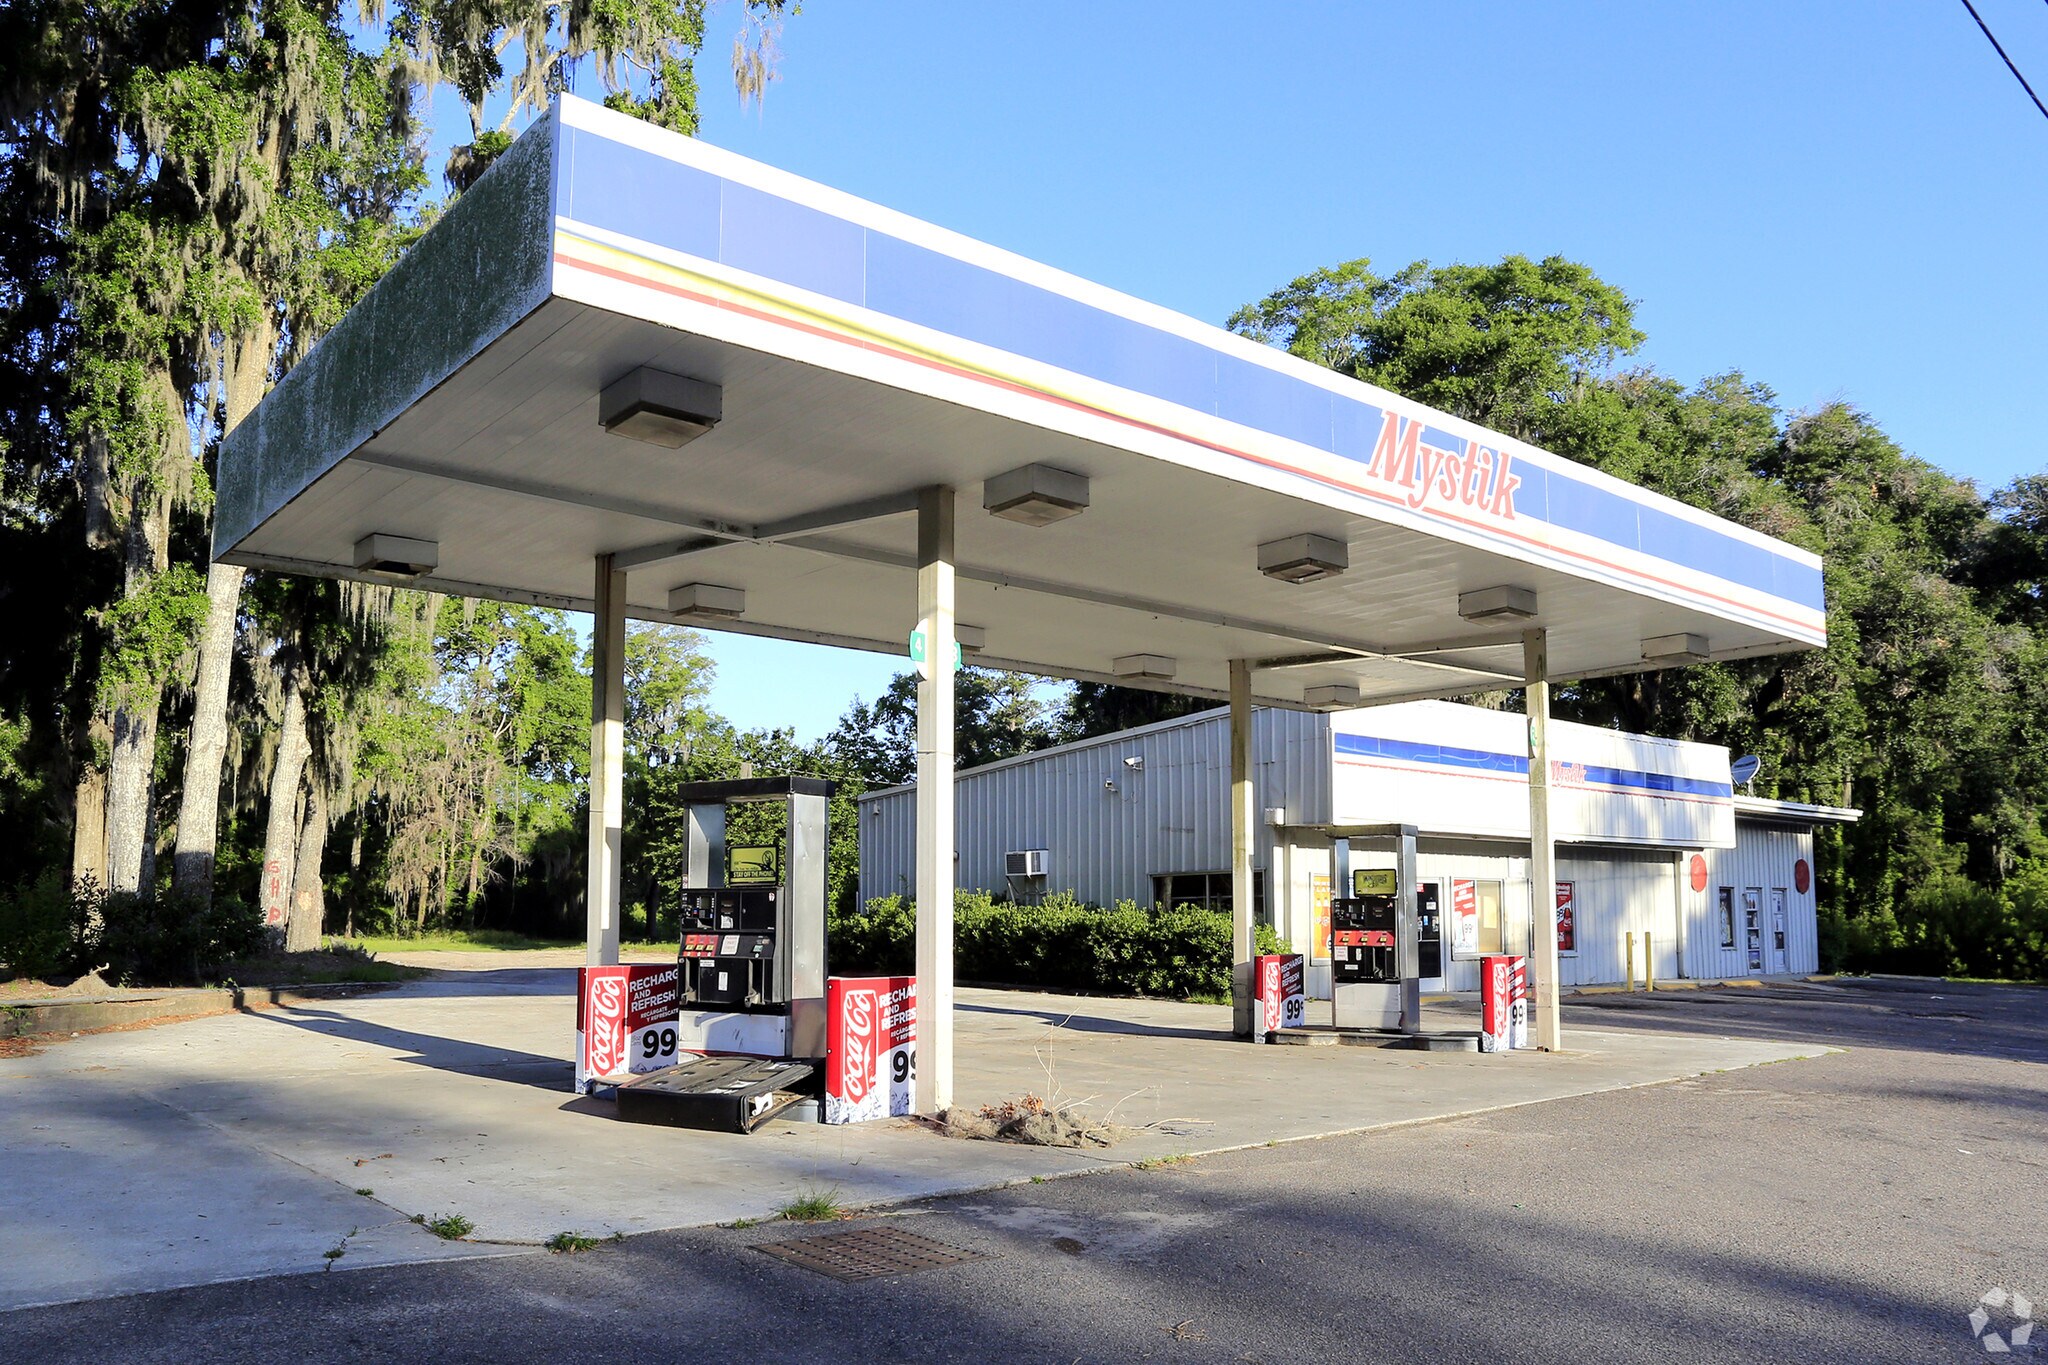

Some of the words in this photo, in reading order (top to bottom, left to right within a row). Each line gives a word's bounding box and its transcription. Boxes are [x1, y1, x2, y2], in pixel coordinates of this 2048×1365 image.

[1367, 411, 1519, 520] Mystik
[631, 990, 676, 1013] REFRESH
[634, 989, 651, 1000] AND
[883, 1004, 900, 1017] AND
[643, 1028, 679, 1058] 99
